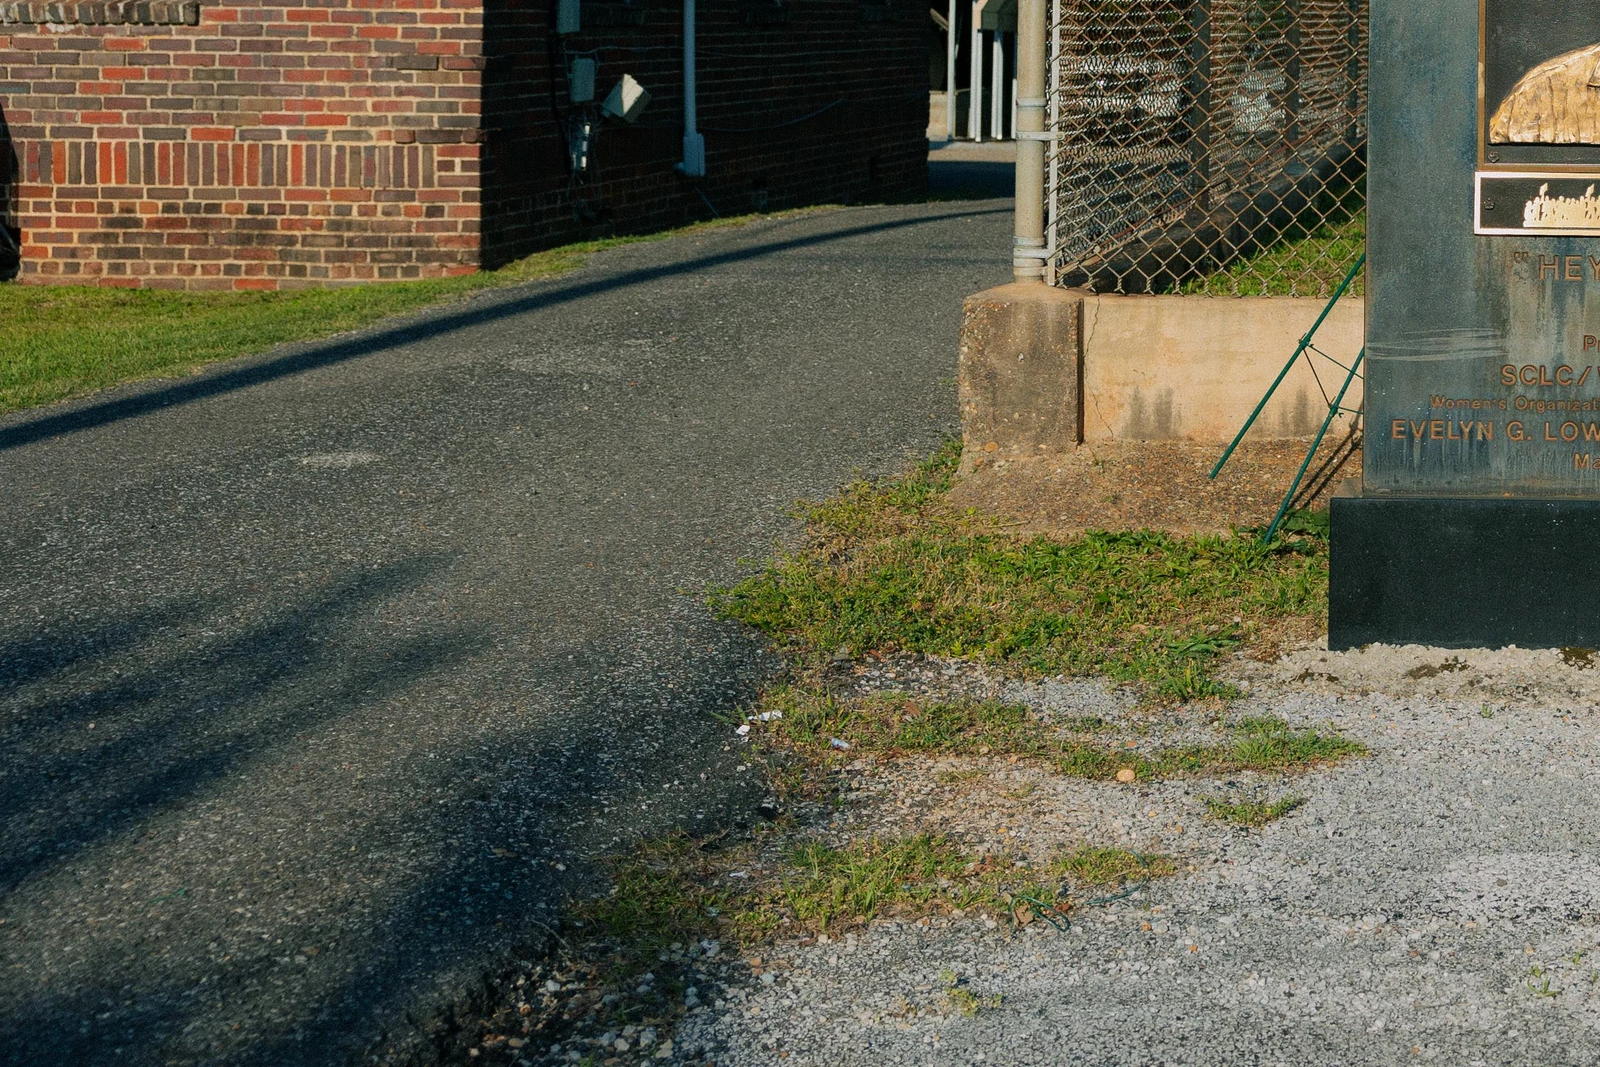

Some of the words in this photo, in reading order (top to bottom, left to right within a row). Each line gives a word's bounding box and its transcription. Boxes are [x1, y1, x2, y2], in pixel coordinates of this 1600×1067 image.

[1430, 394, 1506, 410] Women's
[1391, 420, 1493, 440] EVELYN
[1506, 421, 1532, 441] G.
